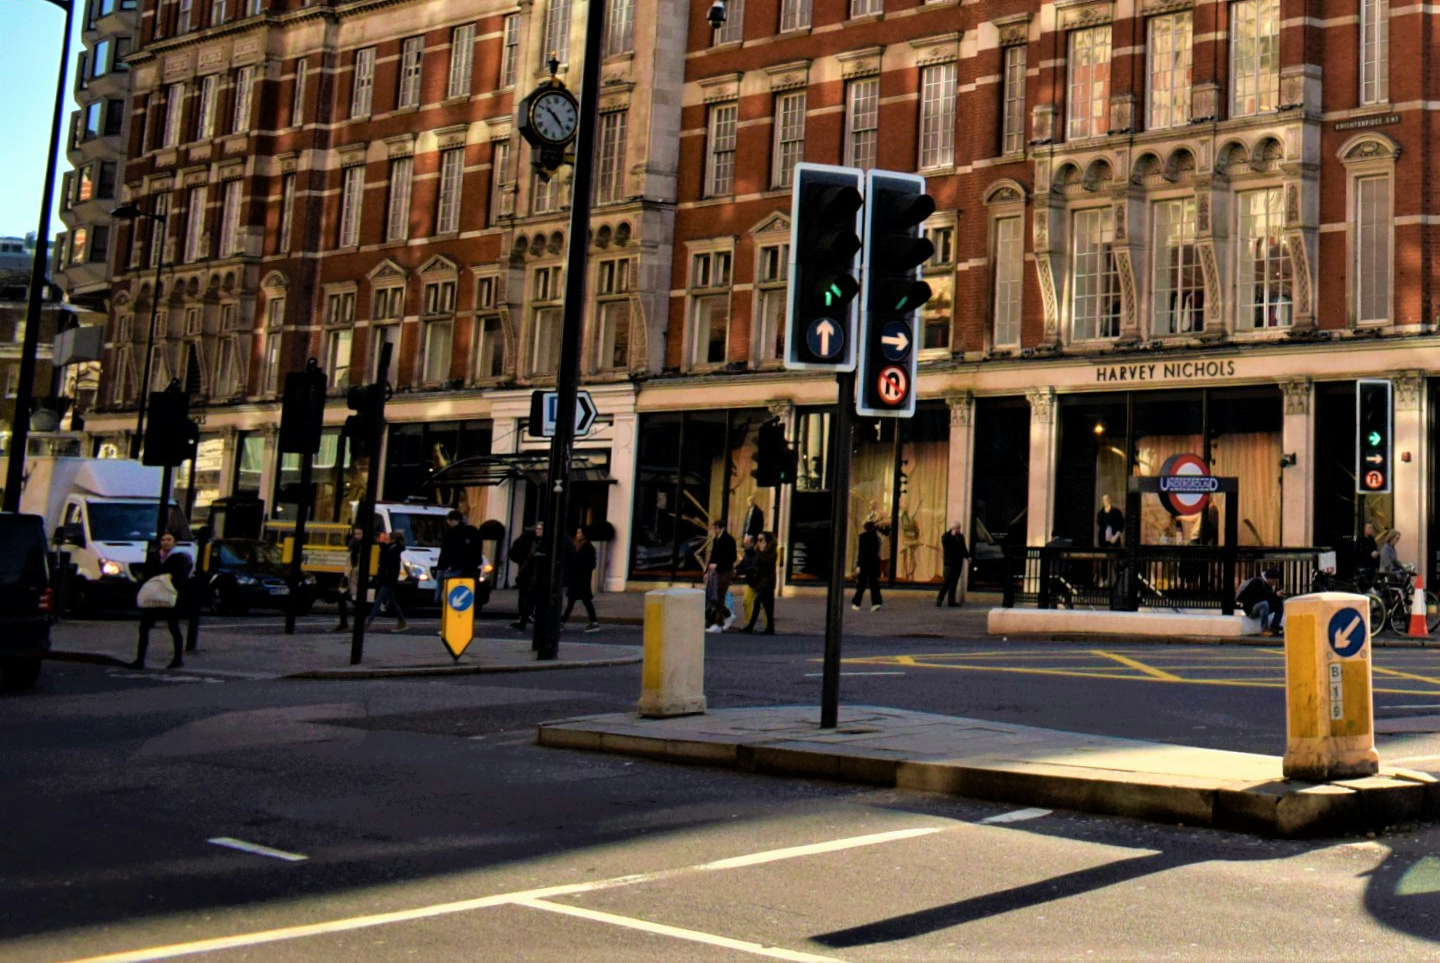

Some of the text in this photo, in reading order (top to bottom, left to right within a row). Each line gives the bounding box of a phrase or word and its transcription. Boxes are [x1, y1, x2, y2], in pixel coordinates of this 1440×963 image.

[1096, 360, 1236, 382] HARVEY NICHOLS
[1160, 477, 1218, 491] UNDERGROUND
